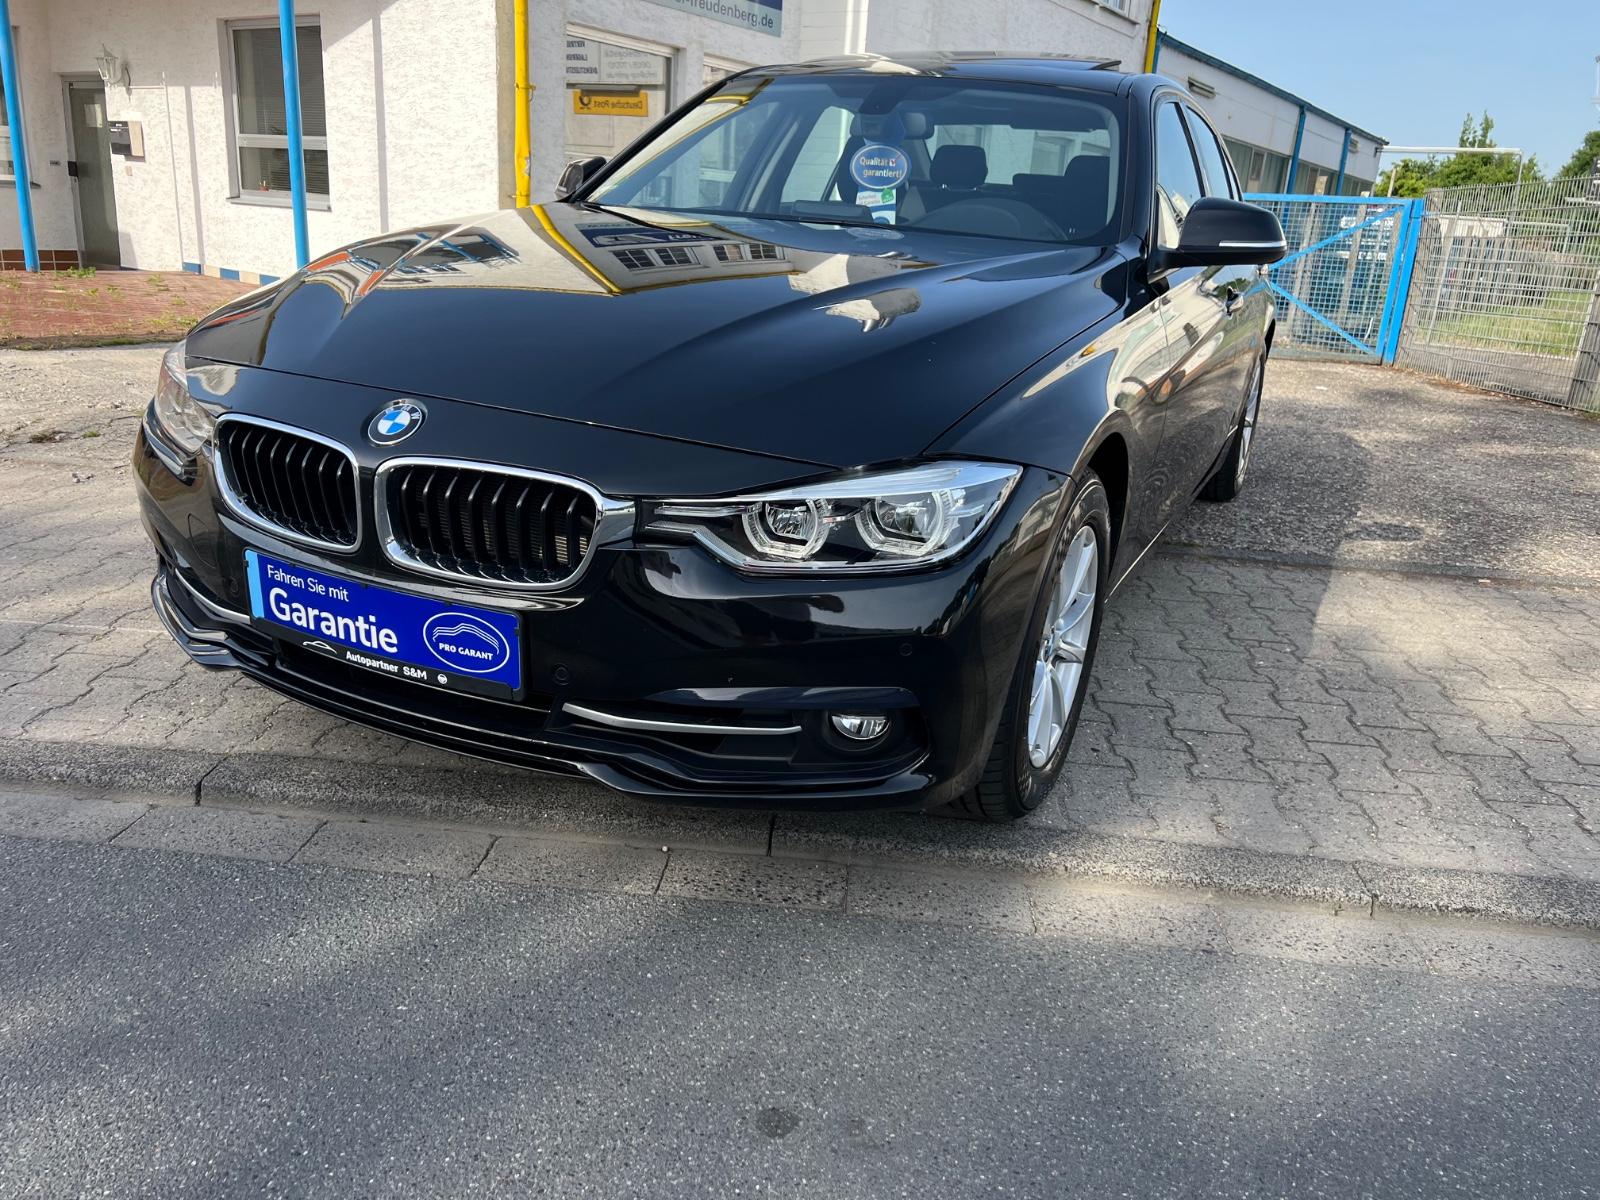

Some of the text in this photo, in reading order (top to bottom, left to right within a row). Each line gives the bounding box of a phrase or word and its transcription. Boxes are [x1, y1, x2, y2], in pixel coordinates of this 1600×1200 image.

[267, 564, 349, 602] Fahren Sie mit
[269, 587, 399, 653] Garantie
[346, 651, 428, 681] Autopartner S&M
[438, 642, 494, 661] PRO GARANT
